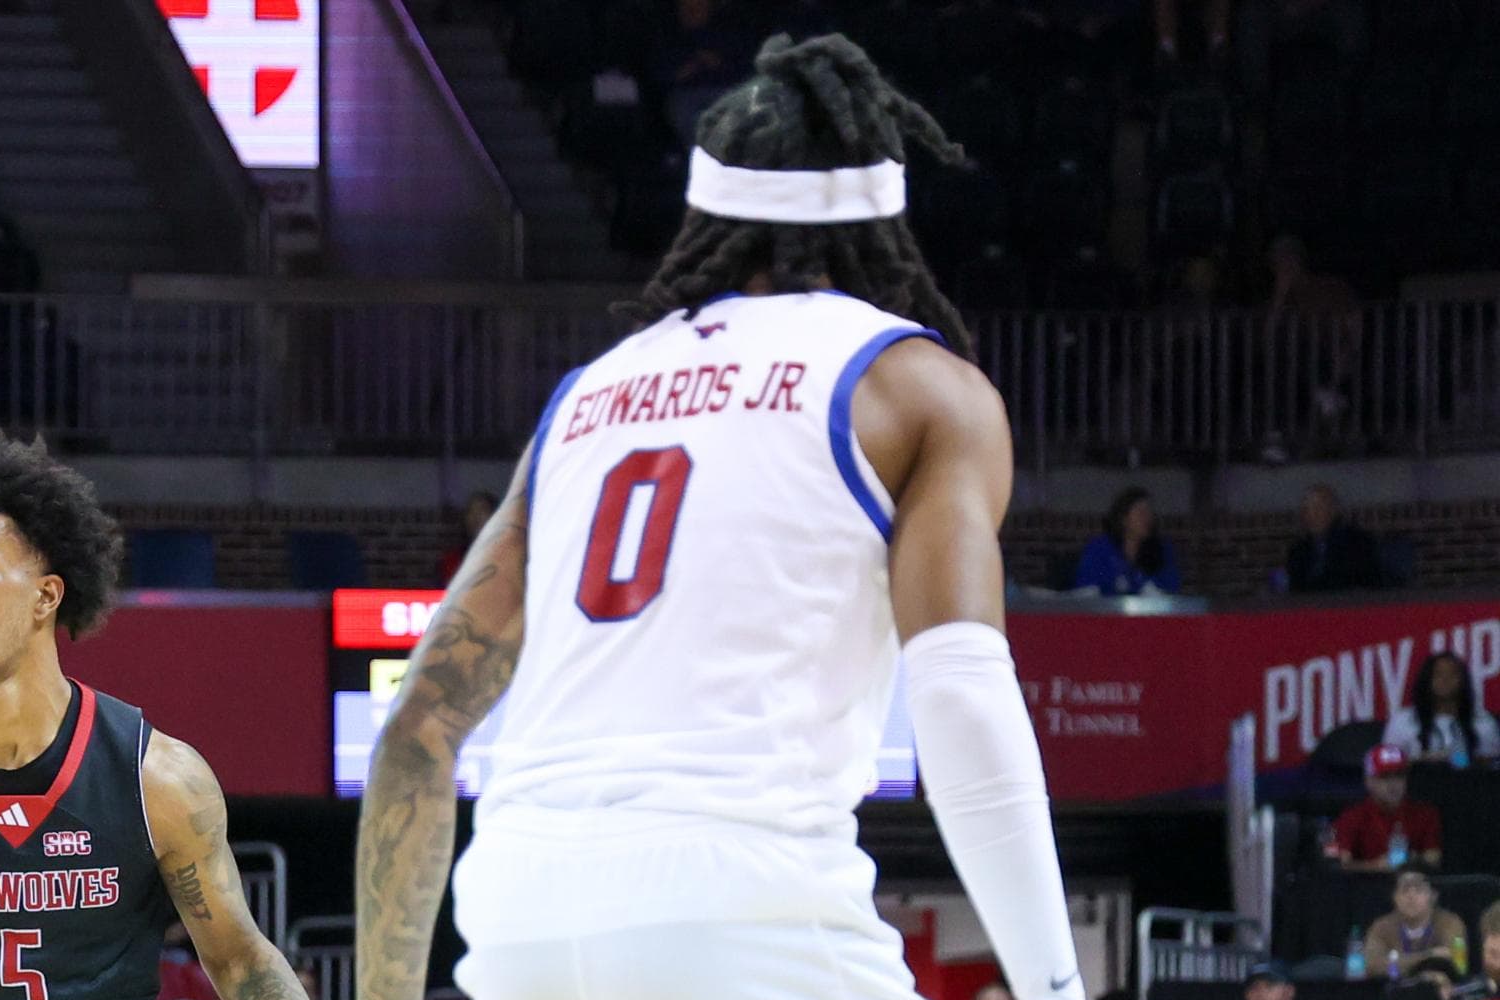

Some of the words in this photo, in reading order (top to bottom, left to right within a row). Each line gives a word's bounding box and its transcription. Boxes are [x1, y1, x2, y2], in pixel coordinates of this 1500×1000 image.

[561, 363, 741, 444] EDWARDS
[744, 361, 807, 412] JR.
[574, 443, 694, 623] 0
[382, 601, 442, 637] SM
[1264, 636, 1415, 764] PONY
[43, 830, 93, 857] SBC
